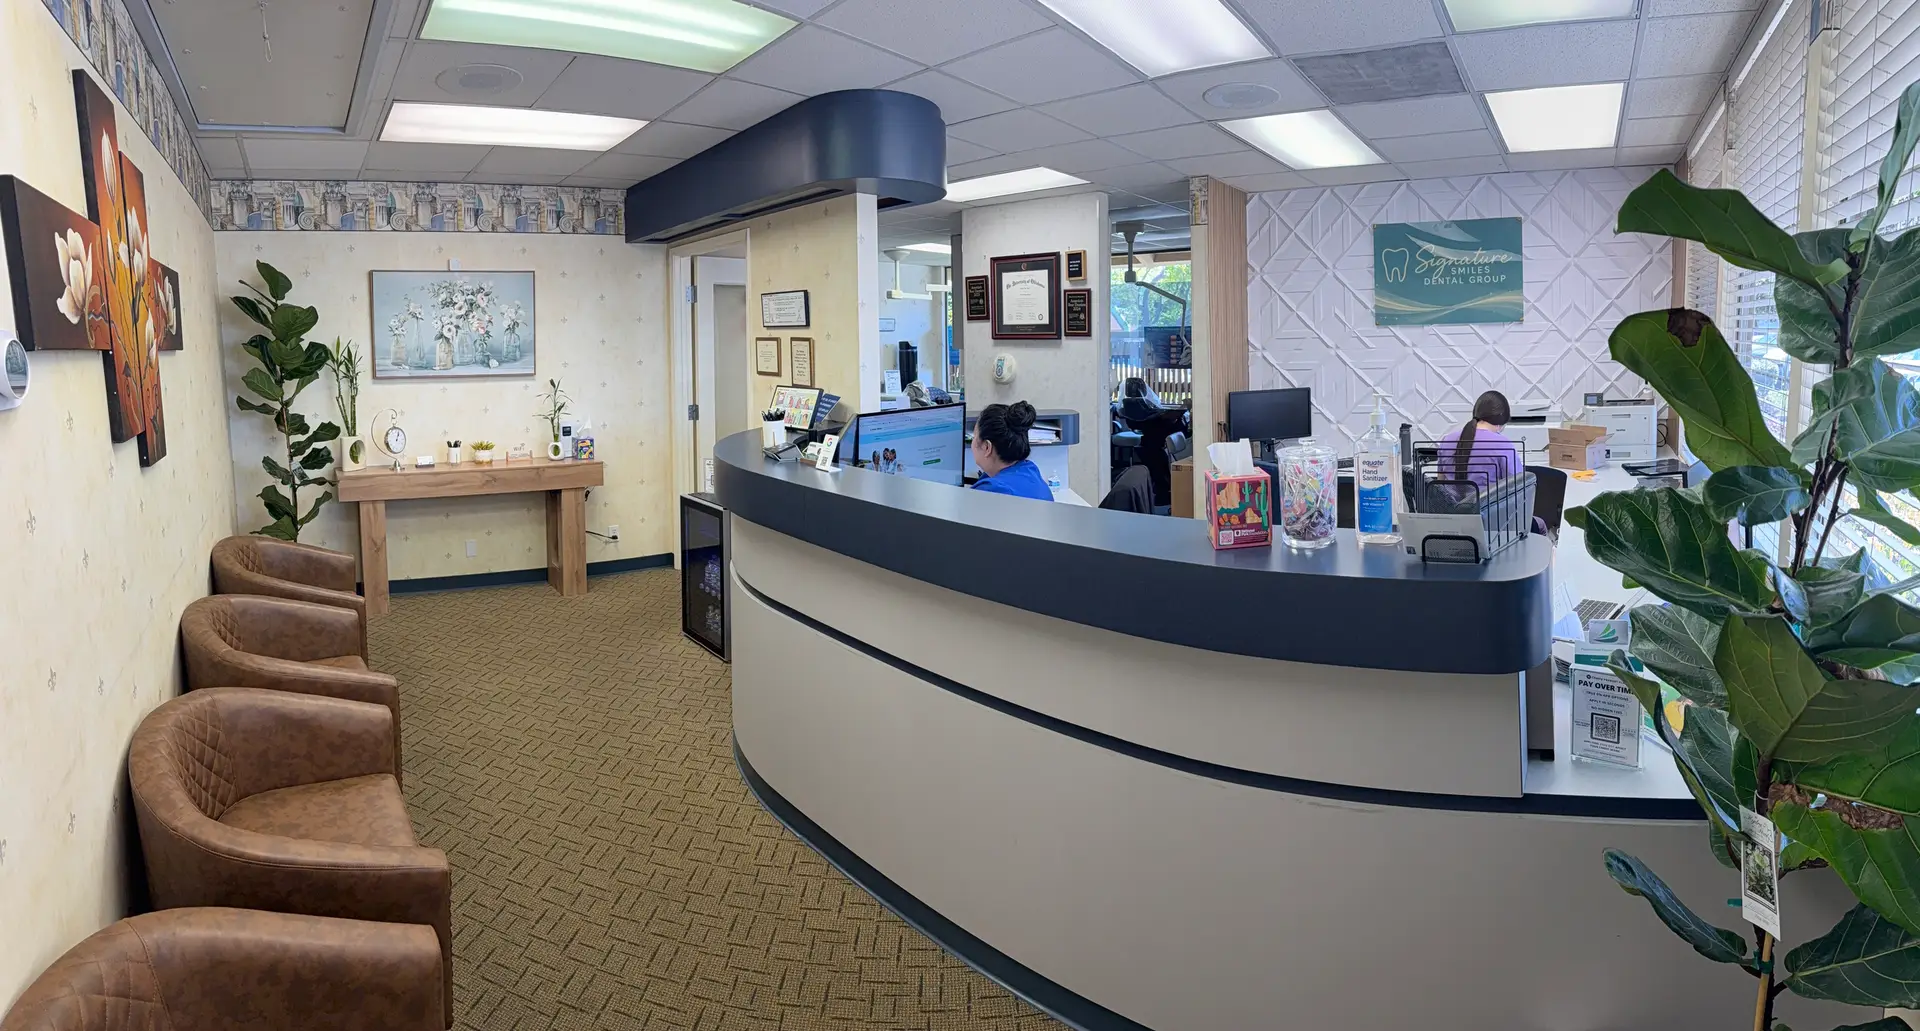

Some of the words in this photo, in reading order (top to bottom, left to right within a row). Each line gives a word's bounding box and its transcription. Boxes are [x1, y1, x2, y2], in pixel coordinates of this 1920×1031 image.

[1415, 244, 1512, 279] Signature
[1451, 266, 1490, 275] SMILES
[1424, 277, 1464, 286] DENTAL
[1469, 275, 1506, 284] GROUP
[1578, 680, 1593, 688] PAY
[1595, 682, 1615, 691] OVER
[1617, 686, 1634, 695] TIM
